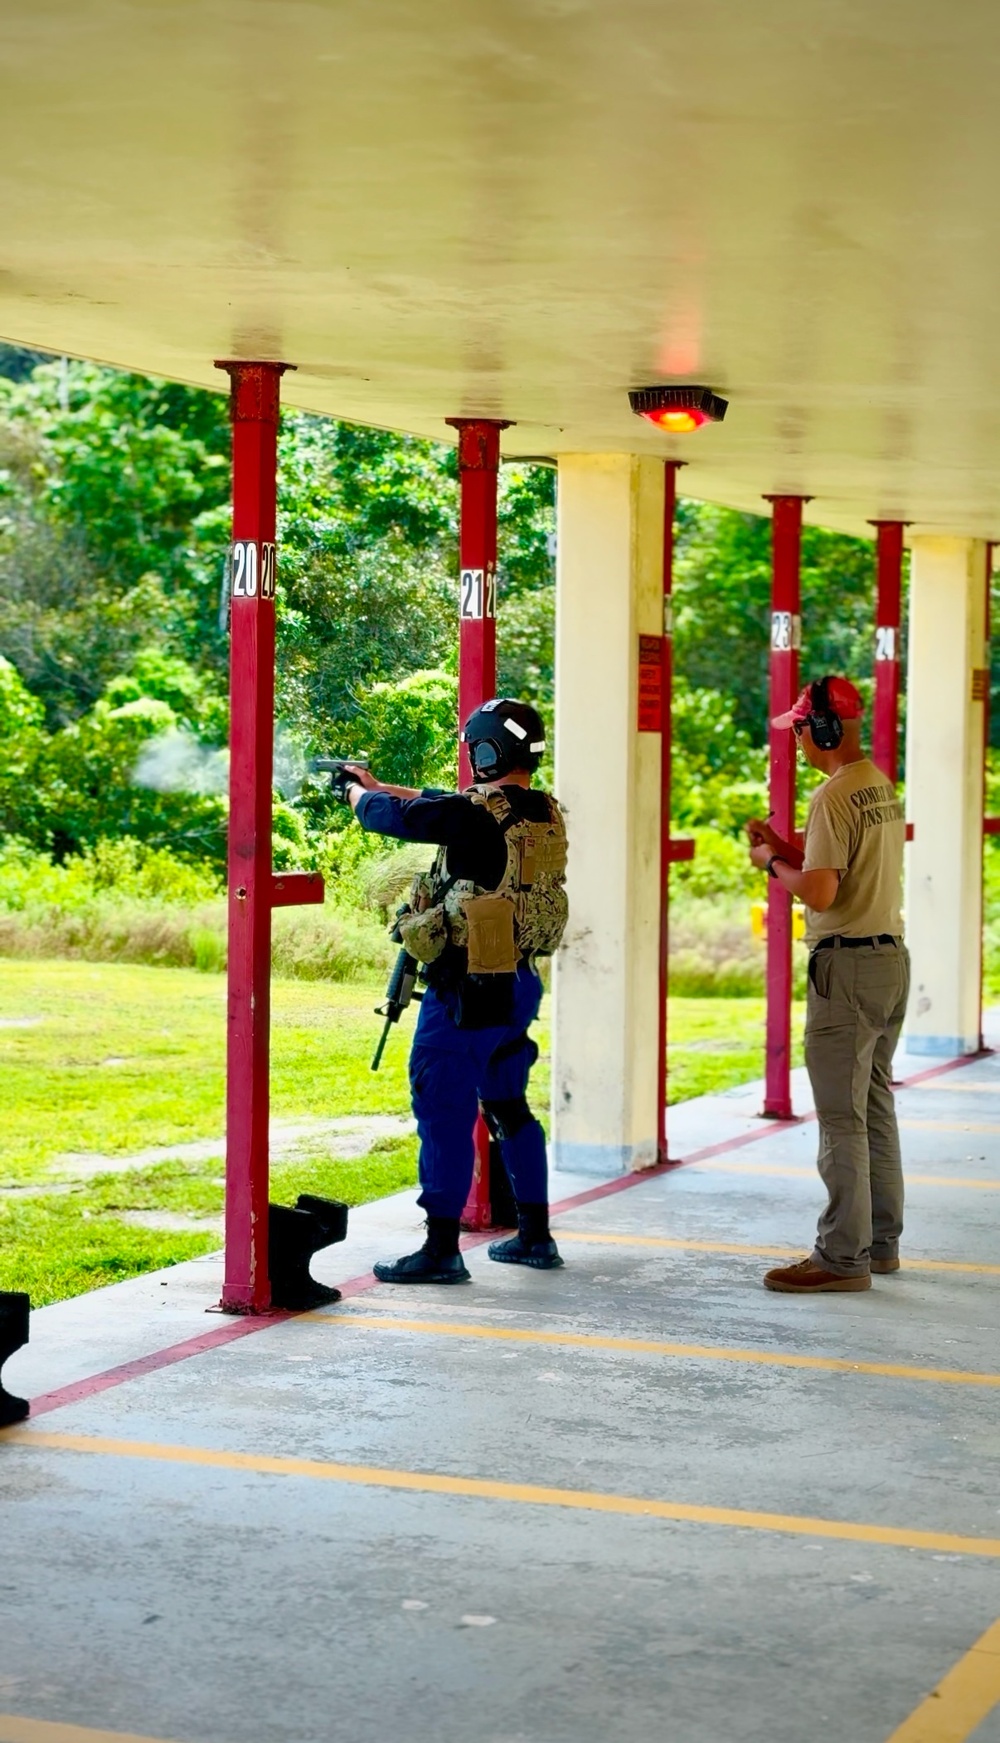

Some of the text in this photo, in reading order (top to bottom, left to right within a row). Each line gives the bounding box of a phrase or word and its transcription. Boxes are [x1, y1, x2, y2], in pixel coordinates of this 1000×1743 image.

[233, 542, 257, 597] 20
[262, 544, 275, 598] 20
[462, 572, 482, 617] 21
[486, 573, 497, 618] 21
[772, 614, 791, 648] 23
[876, 627, 895, 660] 24
